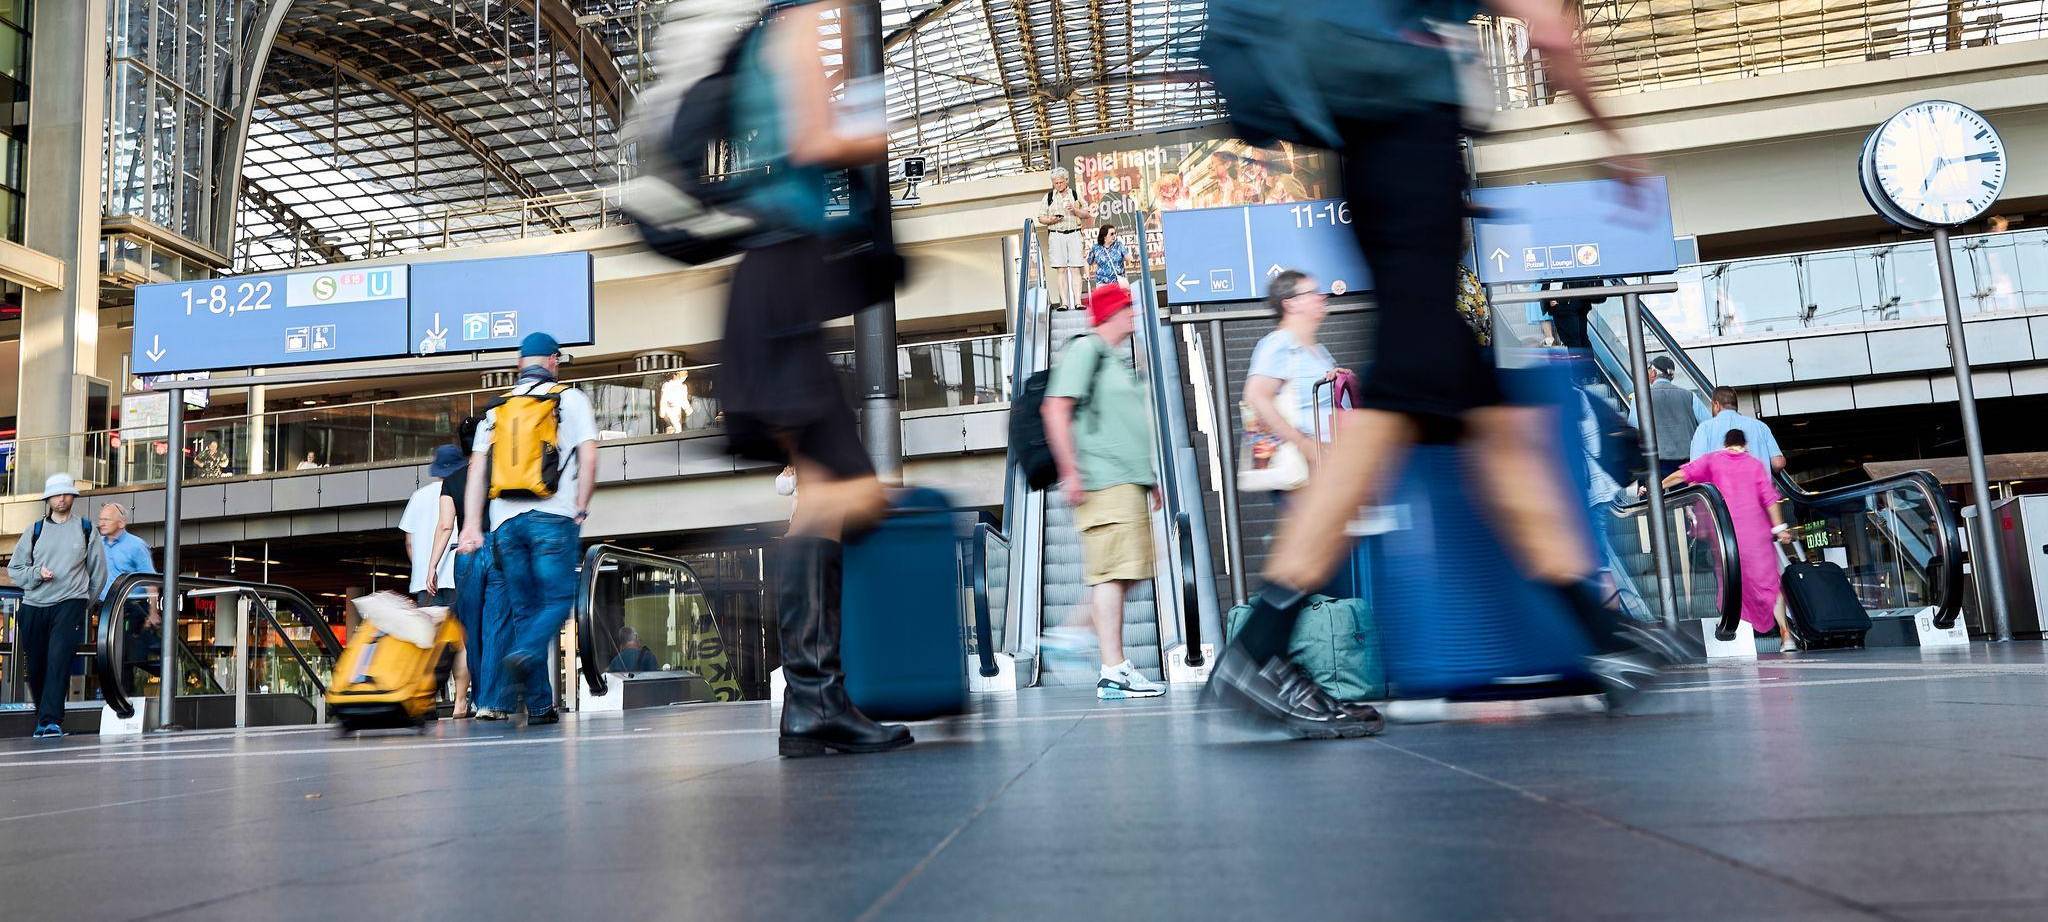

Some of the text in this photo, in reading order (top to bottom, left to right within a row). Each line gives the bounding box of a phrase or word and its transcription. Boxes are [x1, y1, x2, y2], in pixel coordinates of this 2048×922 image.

[1074, 145, 1167, 178] Spiel nach
[1087, 194, 1137, 220] egeln
[1290, 201, 1353, 228] 11-16
[370, 272, 388, 296] U
[1212, 279, 1229, 289] WC
[181, 281, 273, 317] 1-8,22
